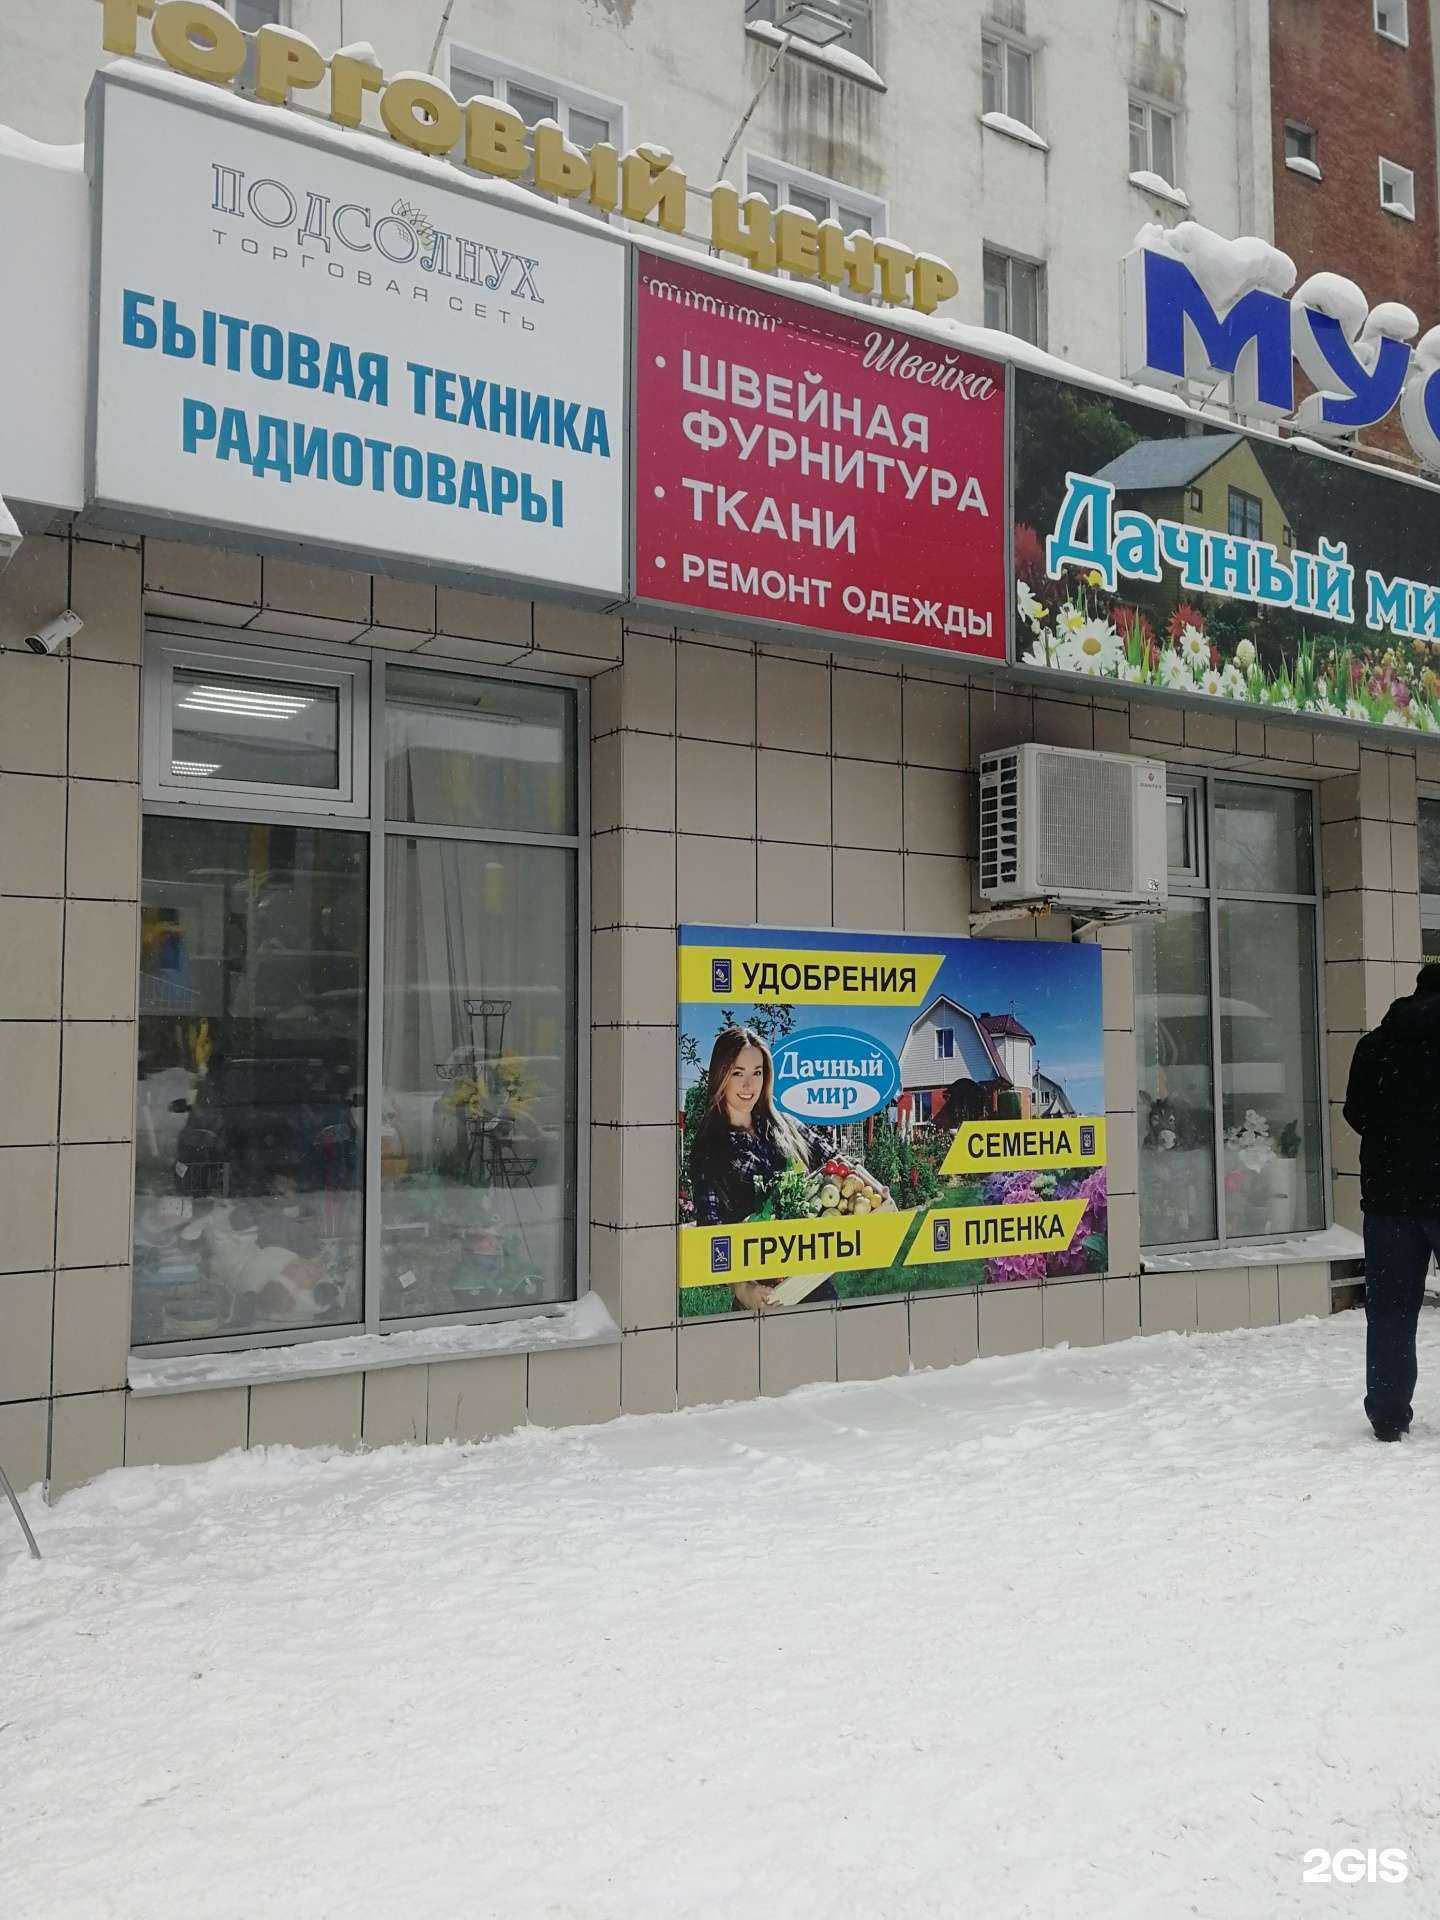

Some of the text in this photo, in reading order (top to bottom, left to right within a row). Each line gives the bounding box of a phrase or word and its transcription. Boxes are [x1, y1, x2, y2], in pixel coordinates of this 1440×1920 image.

[103, 0, 959, 315] ТОРГОВЫЙ ЦЕНТР
[211, 163, 545, 303] ПОДСОЛНУХ
[212, 229, 535, 331] ТОРГОВАЯ СЕТЬ
[122, 289, 611, 459] БЫТОВАЯ ТЕХНИКА
[862, 331, 998, 401] Швейка
[1120, 247, 1440, 452] МУ
[682, 348, 929, 454] ШВЕЙНАЯ
[182, 397, 564, 528] РАДИОТОВАРЫ
[682, 409, 990, 518] ФУРНИТУРА
[682, 477, 857, 556] ТКАНИ
[1046, 471, 1354, 624] Дачный
[682, 553, 993, 639] РЕМОНТ ОДЕЖДЫ
[742, 961, 917, 995] УДОБРЕНИЯ
[778, 1051, 884, 1081] Дачный
[806, 1086, 858, 1110] мир
[967, 1130, 1072, 1159] СЕМЕНА
[743, 1229, 862, 1267] ГРУНТЫ
[965, 1213, 1065, 1246] ПЛЕНКА
